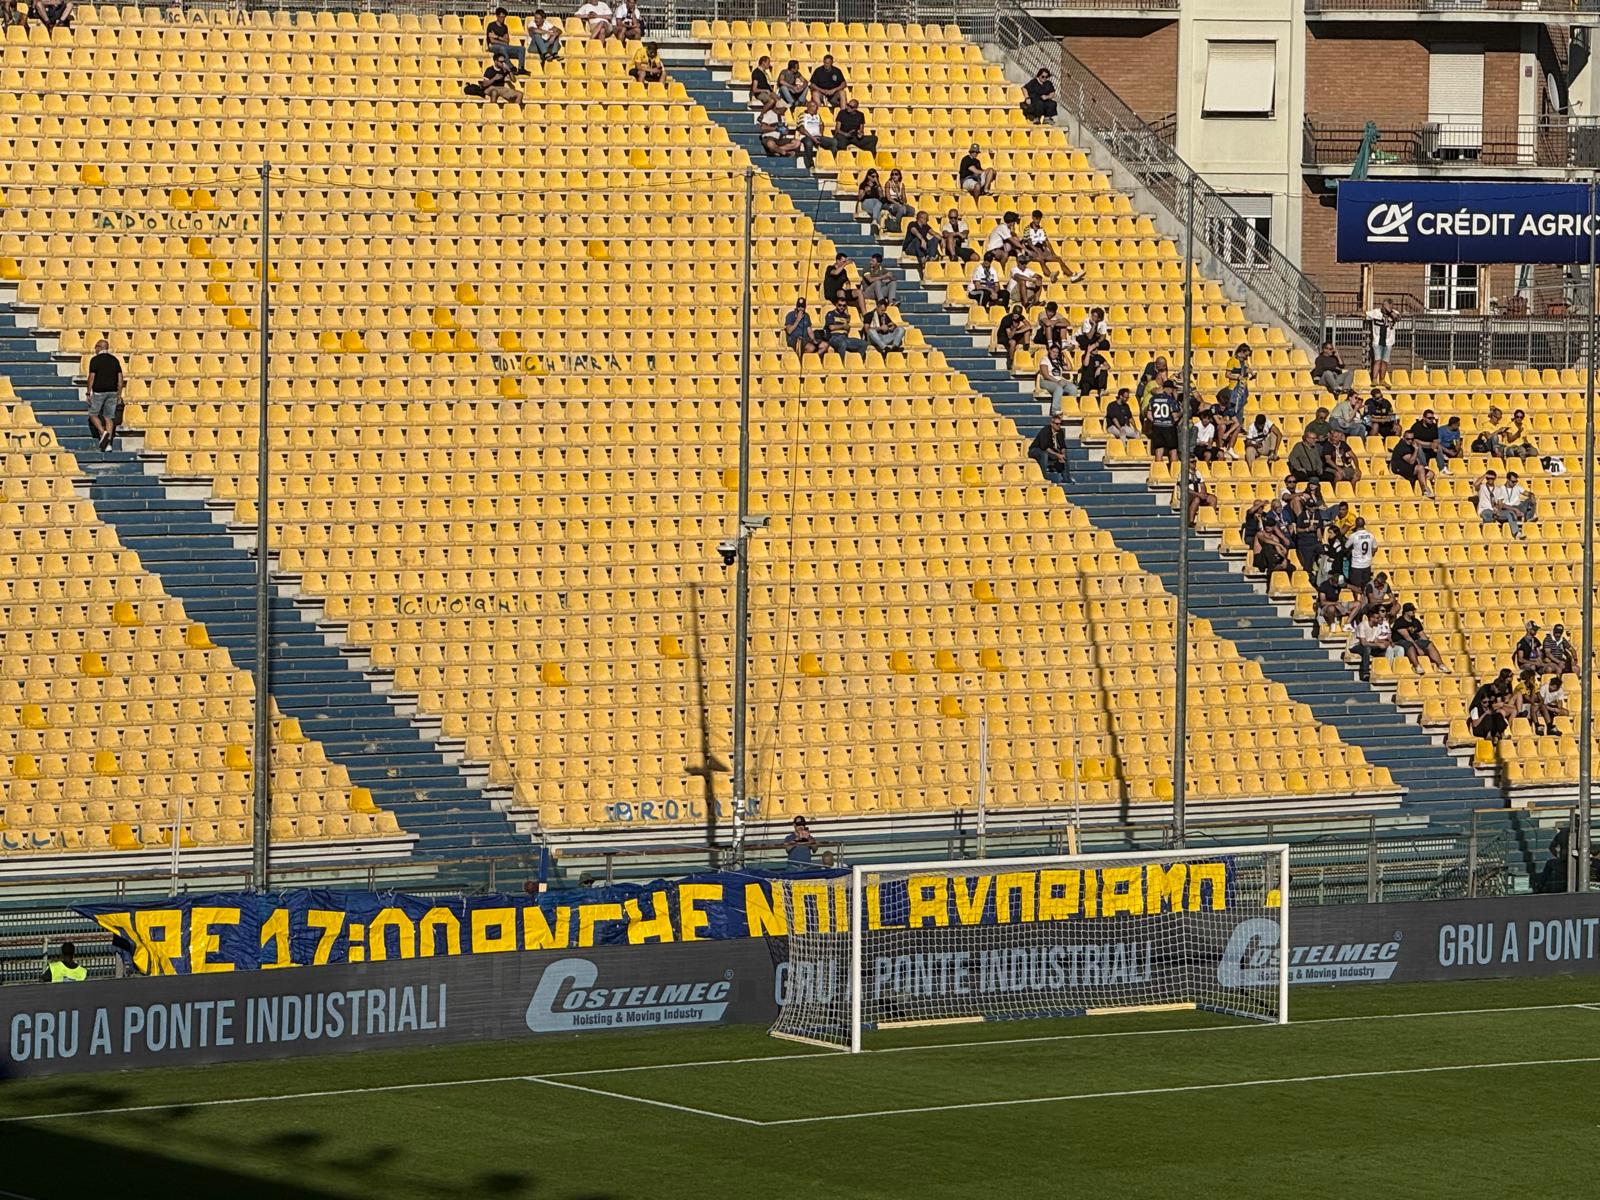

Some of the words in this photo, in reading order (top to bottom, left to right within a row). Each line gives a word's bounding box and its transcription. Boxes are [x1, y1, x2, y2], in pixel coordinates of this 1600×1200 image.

[168, 9, 246, 27] SCALA
[1416, 207, 1516, 236] CRÉDIT
[1152, 402, 1170, 419] 20
[1361, 541, 1369, 556] 9
[744, 879, 849, 938] NOI
[865, 863, 1226, 931] LAVORIAMO
[1438, 922, 1494, 967] GRU
[1500, 921, 1520, 964] A
[1527, 917, 1600, 962] PONT
[1305, 967, 1337, 979] Moving
[1339, 966, 1376, 978] Industry
[525, 957, 731, 1033] COSTELMEC
[10, 1009, 79, 1062] GRU
[89, 1007, 112, 1056] A
[123, 999, 236, 1053] PONTE
[245, 983, 447, 1044] INDUSTRIALI
[572, 1012, 613, 1026] Hoisting
[626, 1009, 661, 1022] Moving
[664, 1007, 703, 1020] Industry
